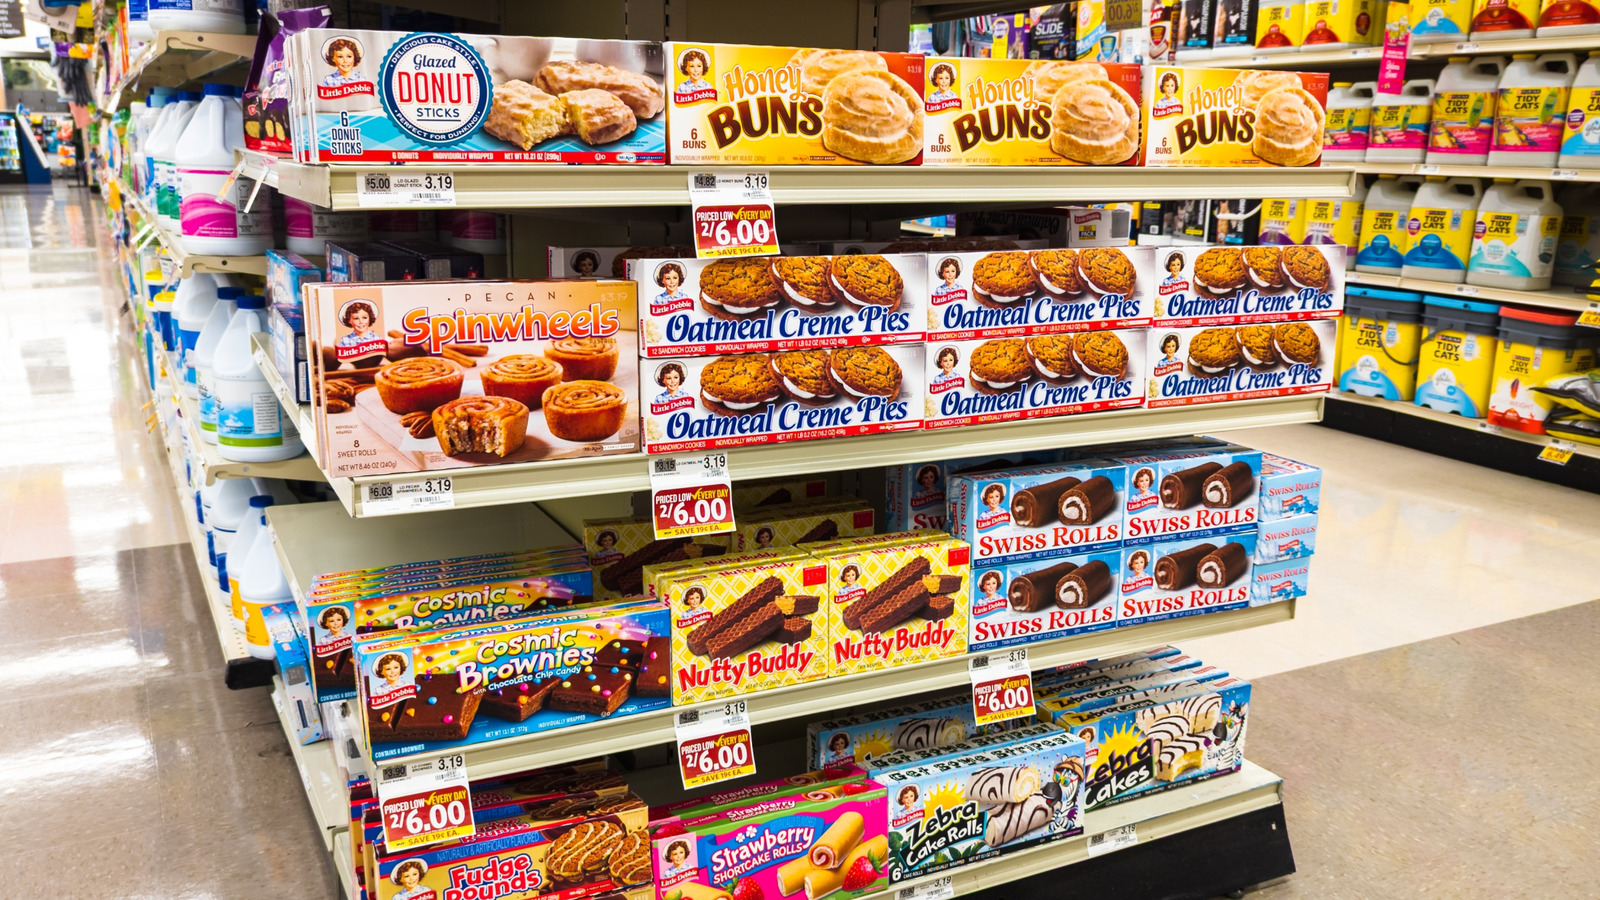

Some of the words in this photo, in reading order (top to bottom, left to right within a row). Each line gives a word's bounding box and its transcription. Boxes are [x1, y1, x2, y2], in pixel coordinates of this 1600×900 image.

[1035, 22, 1064, 35] SLIDE
[392, 38, 428, 64] DELICIOUS
[430, 36, 452, 47] CAKE
[454, 44, 476, 66] STYLE
[413, 54, 456, 70] Glazed
[320, 88, 342, 98] Little
[344, 84, 372, 95] Debbie
[398, 72, 474, 104] DONUT
[726, 66, 806, 101] Honey
[968, 76, 1038, 109] Honey
[1189, 86, 1245, 114] Honey
[340, 112, 348, 127] 6
[396, 112, 428, 138] PERFECT
[448, 114, 480, 138] DUNKING!
[417, 108, 460, 118] STICKS
[708, 97, 824, 149] BUNS
[332, 129, 360, 140] DONUT
[954, 104, 1052, 152] BUNS
[1175, 111, 1255, 154] BUNS
[332, 142, 362, 154] STICKS
[682, 140, 706, 149] BUNS
[366, 178, 390, 190] $5.00
[425, 176, 452, 190] 3.19
[745, 176, 767, 188] 3.19
[696, 212, 718, 221] PRICED
[720, 211, 733, 221] LOW
[740, 211, 758, 220] EVERY
[760, 210, 772, 219] DAY
[465, 292, 556, 302] PECAN
[601, 292, 628, 302] $3.19
[1168, 290, 1242, 317] Oatmeal
[1244, 290, 1293, 313] Creme
[1297, 288, 1332, 309] Pies
[944, 298, 1031, 328] Oatmeal
[1035, 298, 1094, 324] Creme
[1099, 294, 1140, 317] Pies
[404, 303, 619, 354] Spinwheels
[666, 310, 774, 342] Oatmeal
[780, 310, 853, 338] Creme
[858, 306, 909, 332] Pies
[1434, 350, 1459, 361] CATS
[1436, 342, 1460, 352] TIDY
[1162, 369, 1234, 396] Oatmeal
[1236, 368, 1284, 391] Creme
[1289, 364, 1321, 384] Pies
[941, 384, 1026, 416] Oatmeal
[1030, 382, 1088, 408] Creme
[1092, 376, 1132, 400] Pies
[667, 405, 774, 440] Oatmeal
[779, 403, 852, 430] Creme
[857, 396, 907, 422] Pies
[338, 450, 357, 458] SWEET
[358, 449, 376, 457] ROLLS
[685, 441, 706, 449] COOKIES
[380, 461, 397, 469] (240g)
[704, 456, 725, 468] 3.19
[370, 486, 392, 497] $6.03
[425, 480, 451, 493] 3.19
[656, 494, 677, 504] PRICED
[678, 493, 692, 502] LOW
[698, 490, 715, 499] EVERY
[717, 489, 728, 498] DAY
[1129, 516, 1190, 536] SWISS
[1196, 508, 1254, 528] ROLLS
[980, 533, 1046, 556] SWISS
[1053, 525, 1118, 547] ROLLS
[1123, 596, 1184, 618] SWISS
[1191, 587, 1247, 607] ROLLS
[975, 618, 1042, 641] SWISS
[1049, 606, 1113, 629] ROLLS
[477, 627, 579, 664] Cosmic
[834, 634, 893, 664] Nutty
[896, 620, 955, 651] Buddy
[678, 660, 744, 692] Nutty
[748, 643, 813, 676] Buddy
[1009, 650, 1026, 662] 3.19
[456, 647, 595, 694] Brownies
[488, 674, 533, 690] Chocolate
[536, 670, 554, 680] Chip
[556, 666, 581, 675] Candy
[372, 696, 391, 705] Little
[392, 688, 414, 698] Debbie
[725, 702, 745, 715] 3.19
[538, 718, 566, 728] INDIVIDUALLY
[567, 714, 586, 723] WRAPPED
[1072, 707, 1116, 722] Zebra
[1117, 699, 1155, 712] Cakes
[375, 748, 396, 758] CONTAINS
[402, 745, 424, 753] BROWNIES
[438, 756, 463, 770] 3.19
[701, 775, 719, 783] SAVE
[890, 768, 928, 780] Get
[934, 755, 988, 772] Some
[385, 803, 409, 814] PRICED
[410, 799, 425, 809] LOW
[432, 793, 452, 805] EVERY
[454, 790, 466, 800] DAY
[906, 802, 976, 847] Zebra
[409, 837, 429, 845] SAVE
[437, 844, 468, 861] NATURALLY
[469, 846, 474, 855] &
[475, 837, 511, 854] ARTIFICIALLY
[509, 831, 540, 846] FLAVORED
[712, 827, 814, 872] Strawberry
[906, 839, 945, 866] Cake
[947, 820, 983, 842] Rolls
[452, 855, 530, 888] Fudge
[713, 854, 770, 884] SHORTCAKE
[773, 843, 804, 860] ROLLS
